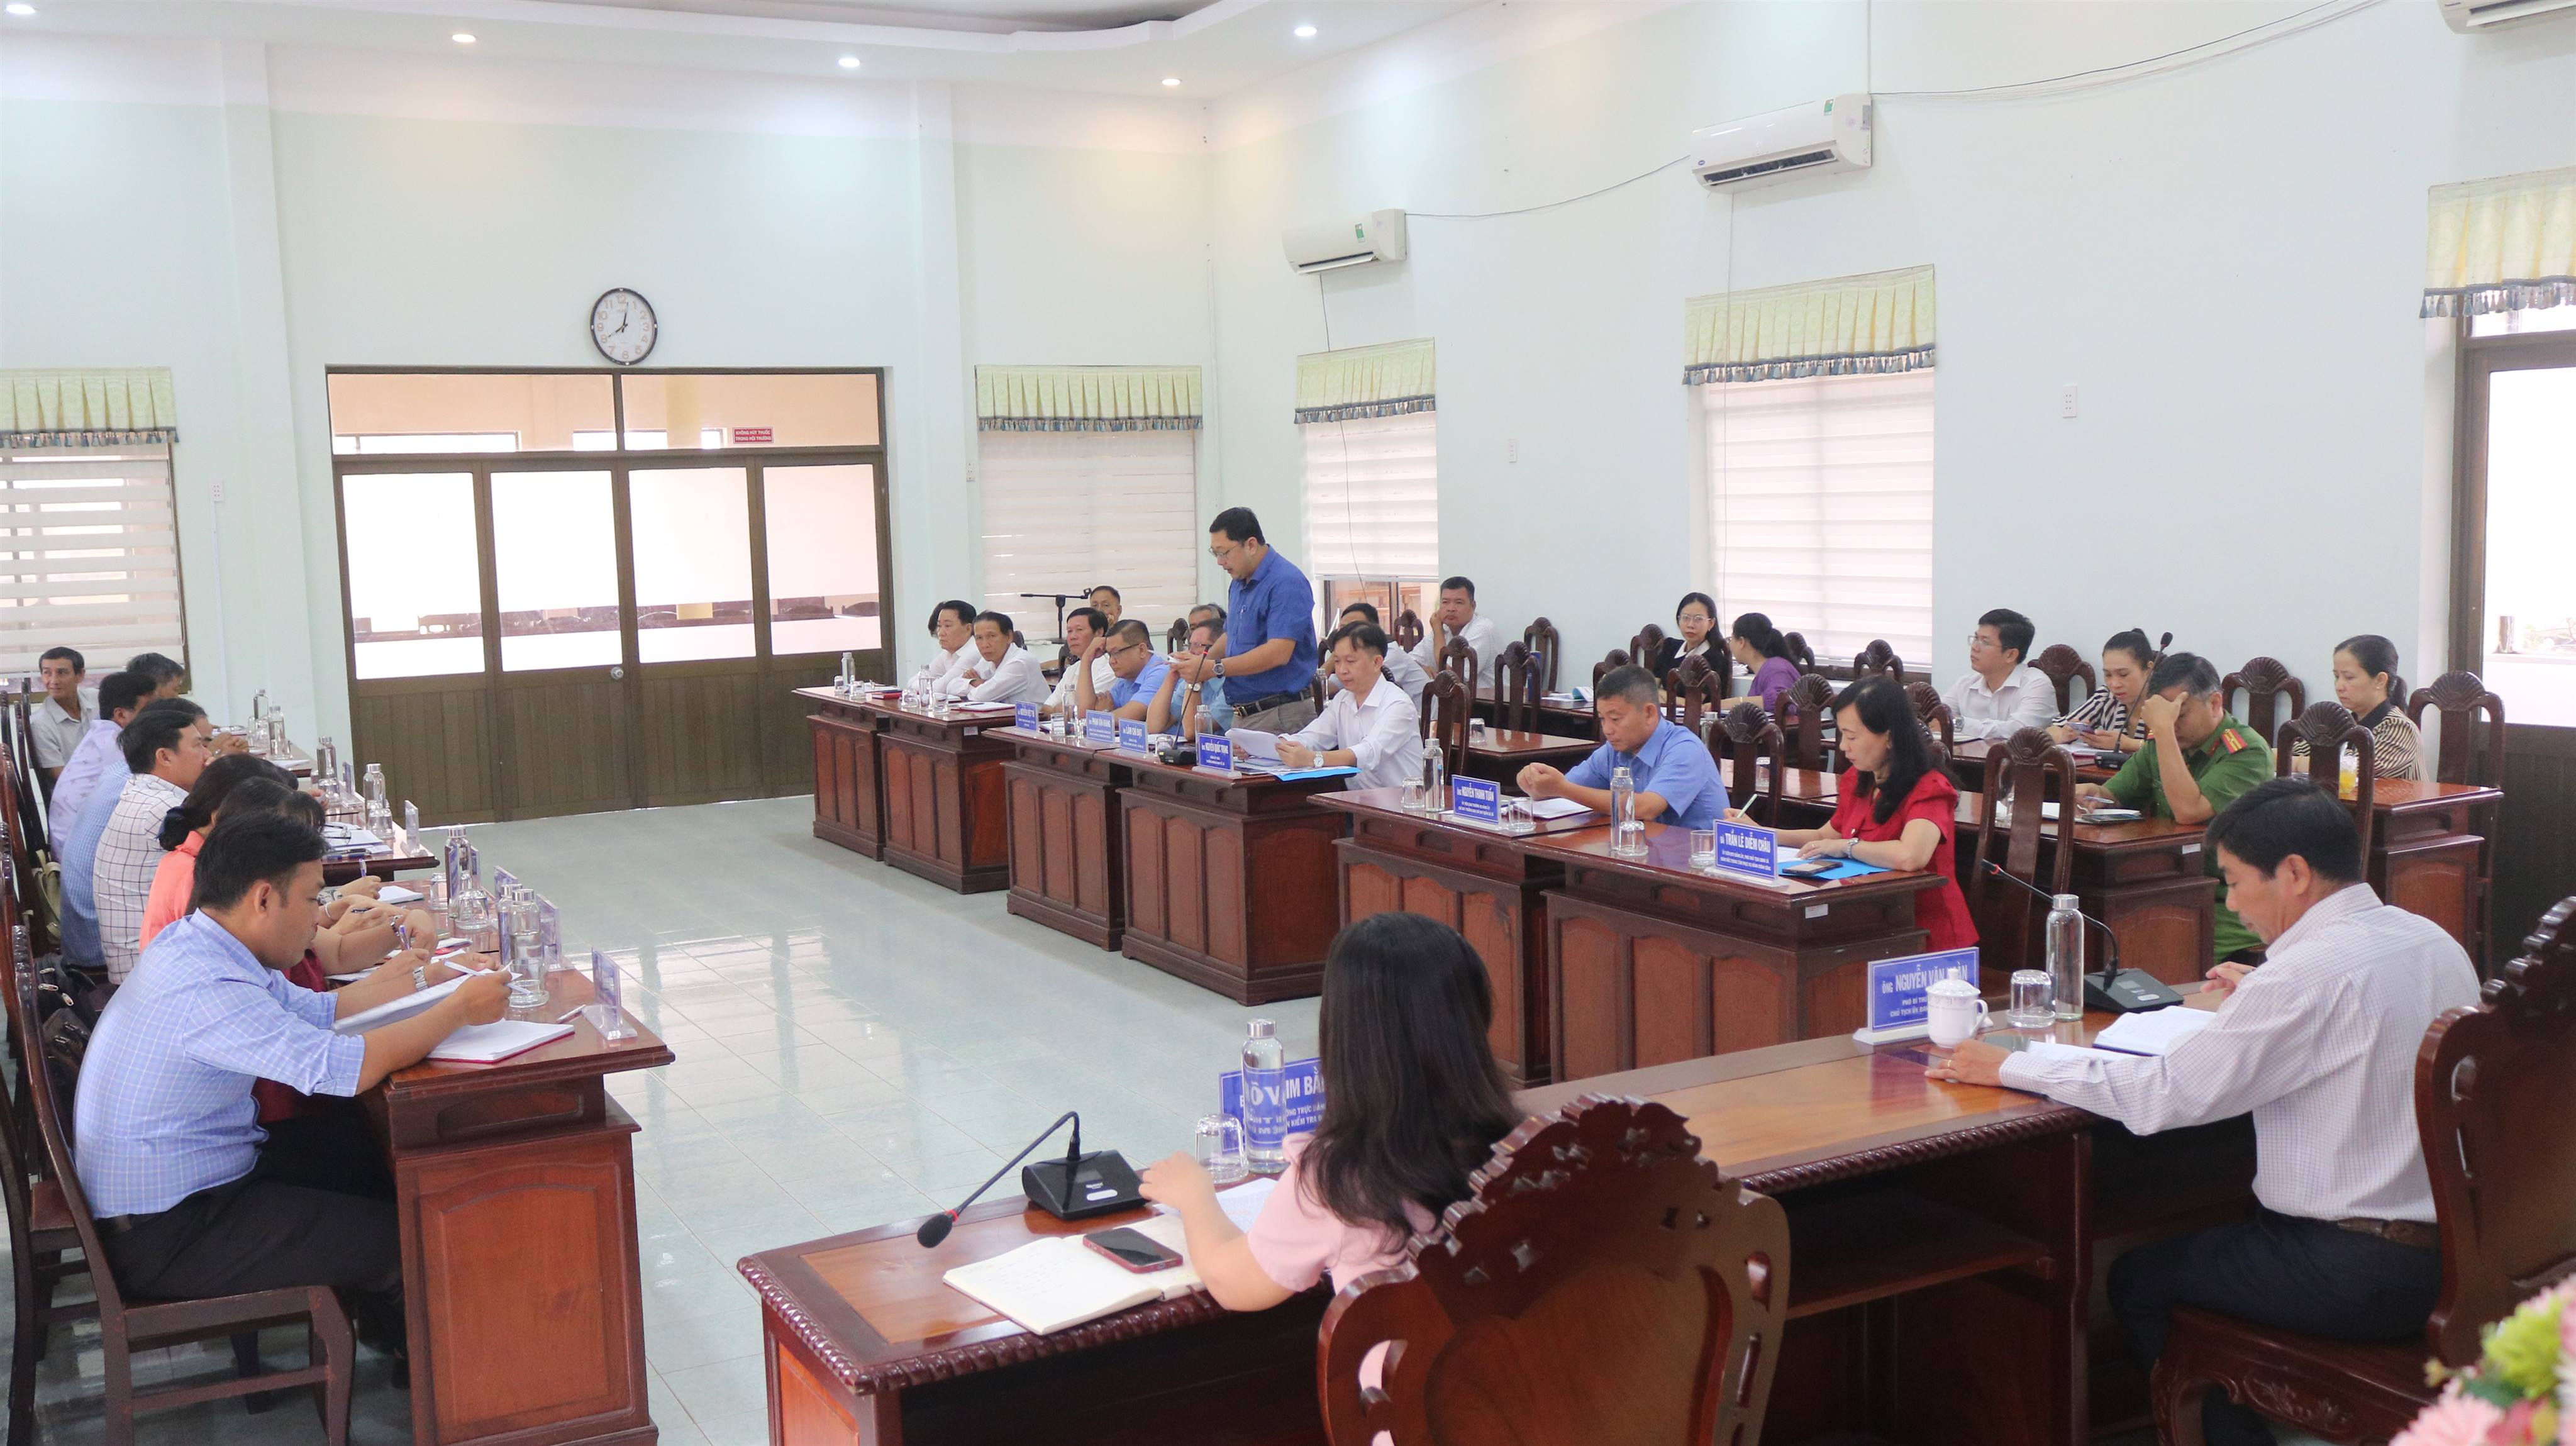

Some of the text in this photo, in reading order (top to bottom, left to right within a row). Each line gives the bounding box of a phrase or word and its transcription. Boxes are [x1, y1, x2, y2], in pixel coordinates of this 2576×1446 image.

[604, 299, 613, 309] 11
[616, 294, 626, 304] 12
[633, 301, 637, 309] 1
[597, 311, 608, 320] 10
[640, 311, 647, 320] 2
[643, 322, 650, 331] 3
[641, 335, 648, 343] 4
[608, 345, 615, 355] 7
[635, 345, 642, 355] 5
[1738, 832, 1745, 848] LÊ
[1758, 837, 1770, 853] CHÂU
[1882, 981, 1894, 993] ÔNG
[1896, 964, 1927, 992] NGUYỄN
[1285, 1077, 1301, 1099] IM
